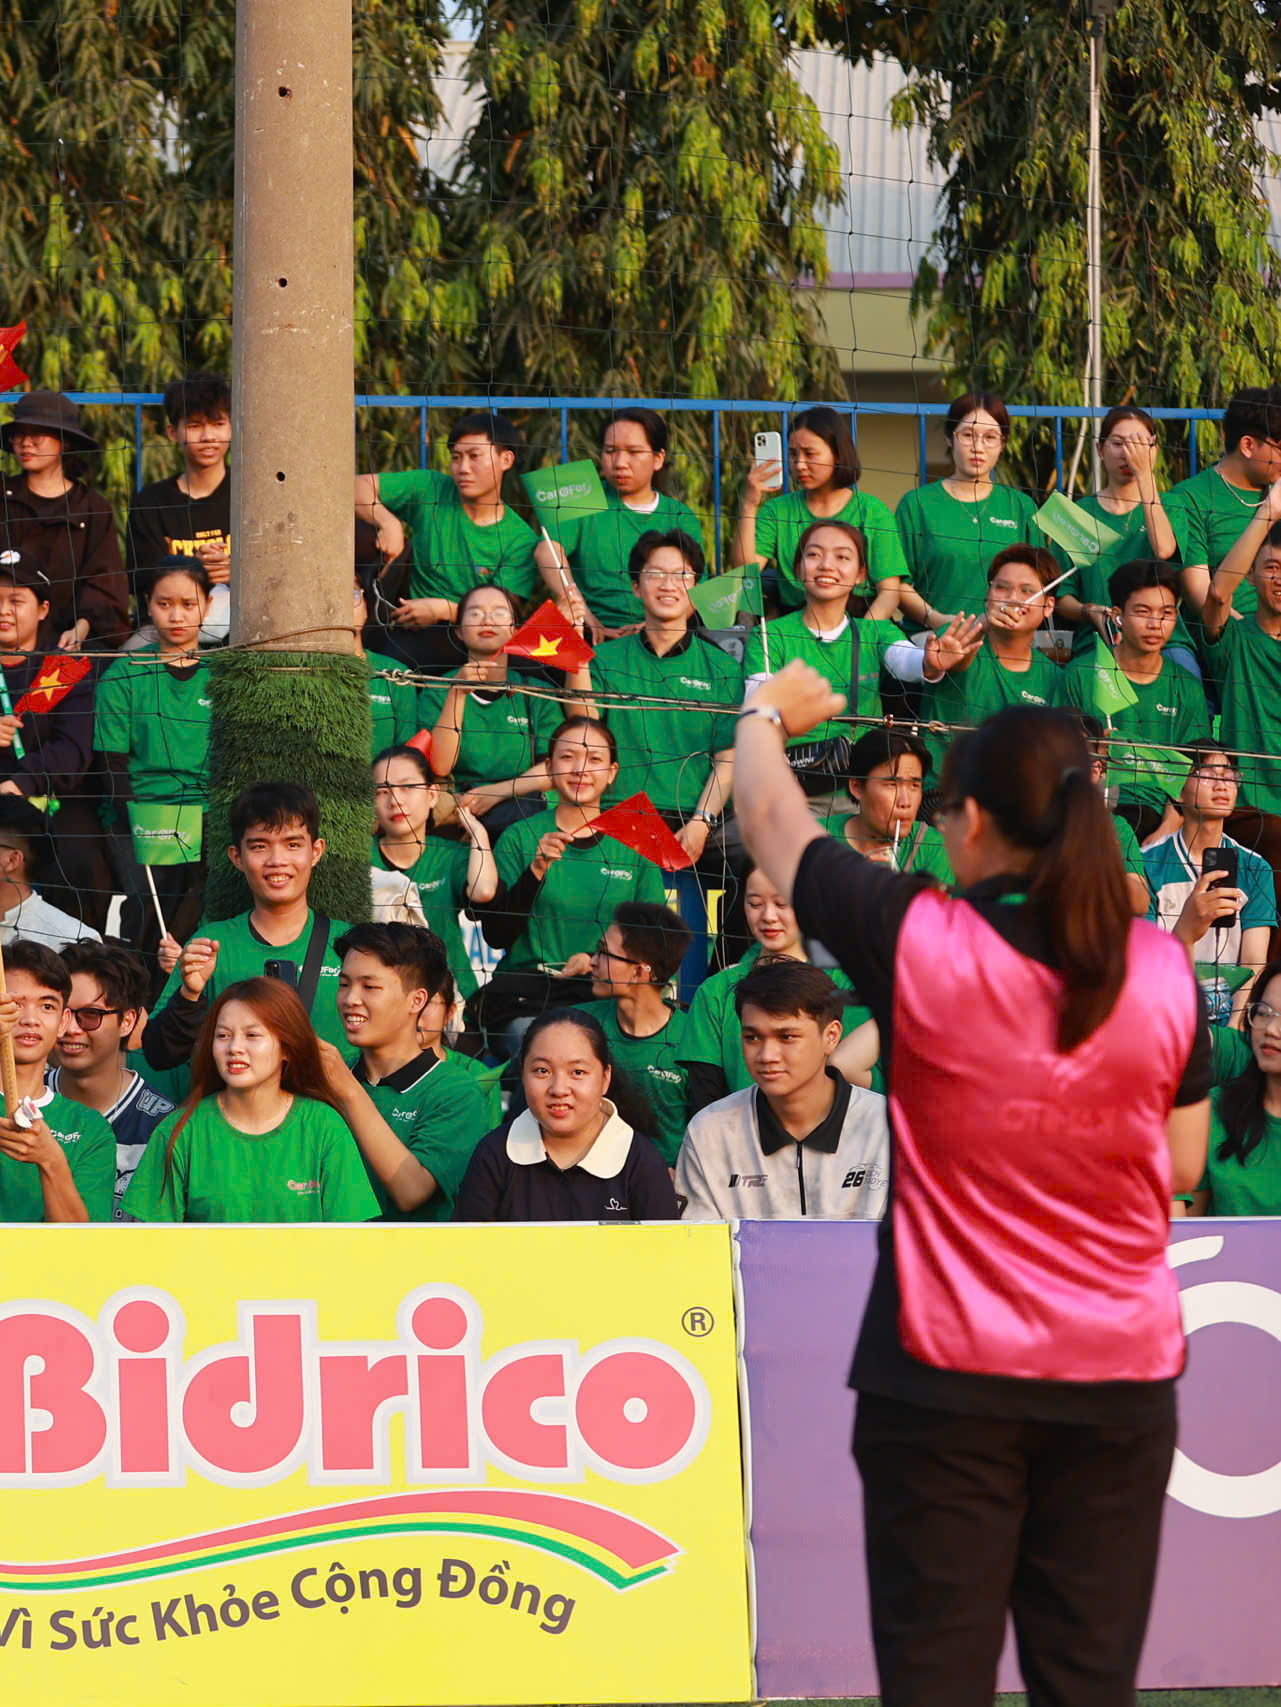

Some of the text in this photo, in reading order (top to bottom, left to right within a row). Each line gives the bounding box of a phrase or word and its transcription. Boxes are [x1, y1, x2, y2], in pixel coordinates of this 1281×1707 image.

[137, 1089, 175, 1117] UP
[841, 1170, 866, 1188] 26
[49, 1606, 140, 1651] Sức
[151, 1583, 280, 1641] Khỏe
[291, 1561, 422, 1615] Cộng
[437, 1557, 576, 1636] Đồng
